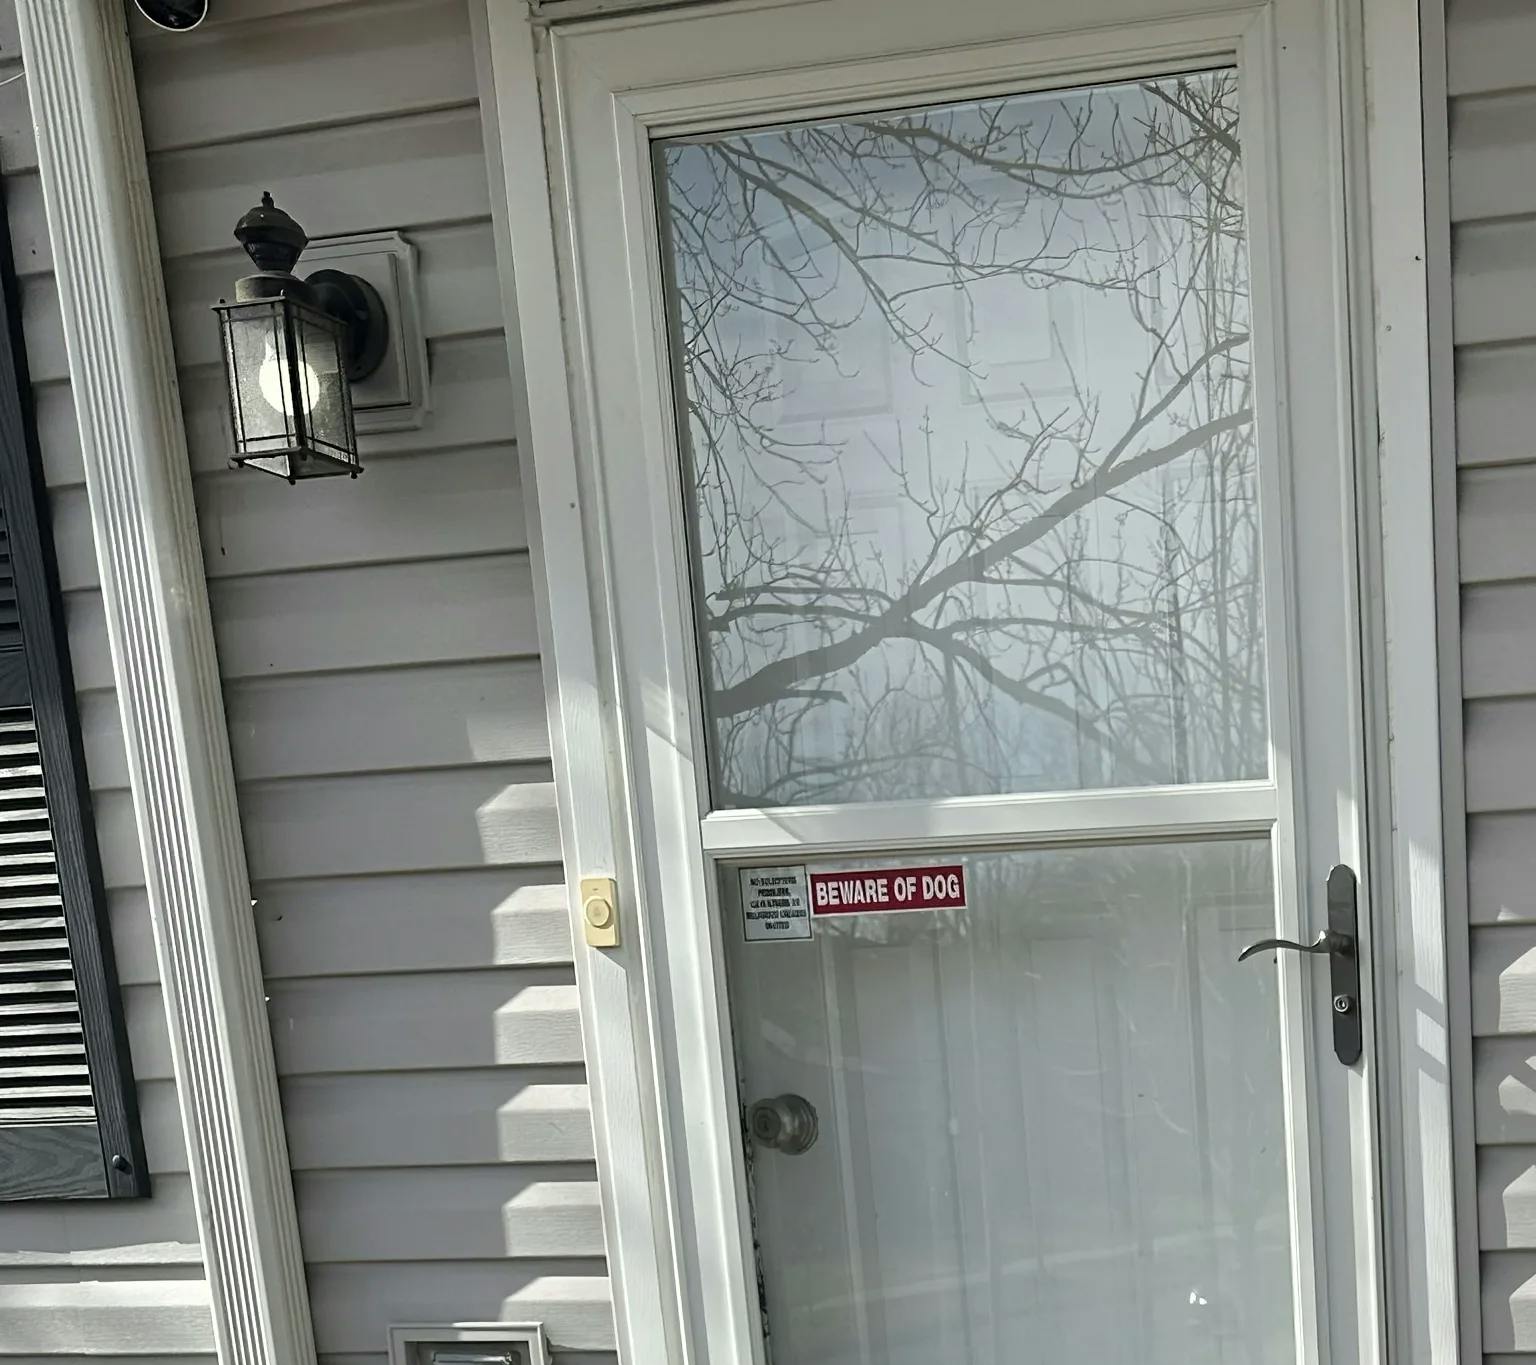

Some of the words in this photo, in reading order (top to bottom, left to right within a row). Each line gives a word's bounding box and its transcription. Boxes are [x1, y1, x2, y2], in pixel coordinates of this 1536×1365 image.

[815, 876, 890, 906] BEWARE
[893, 875, 917, 902] OF
[921, 873, 961, 900] DOG
